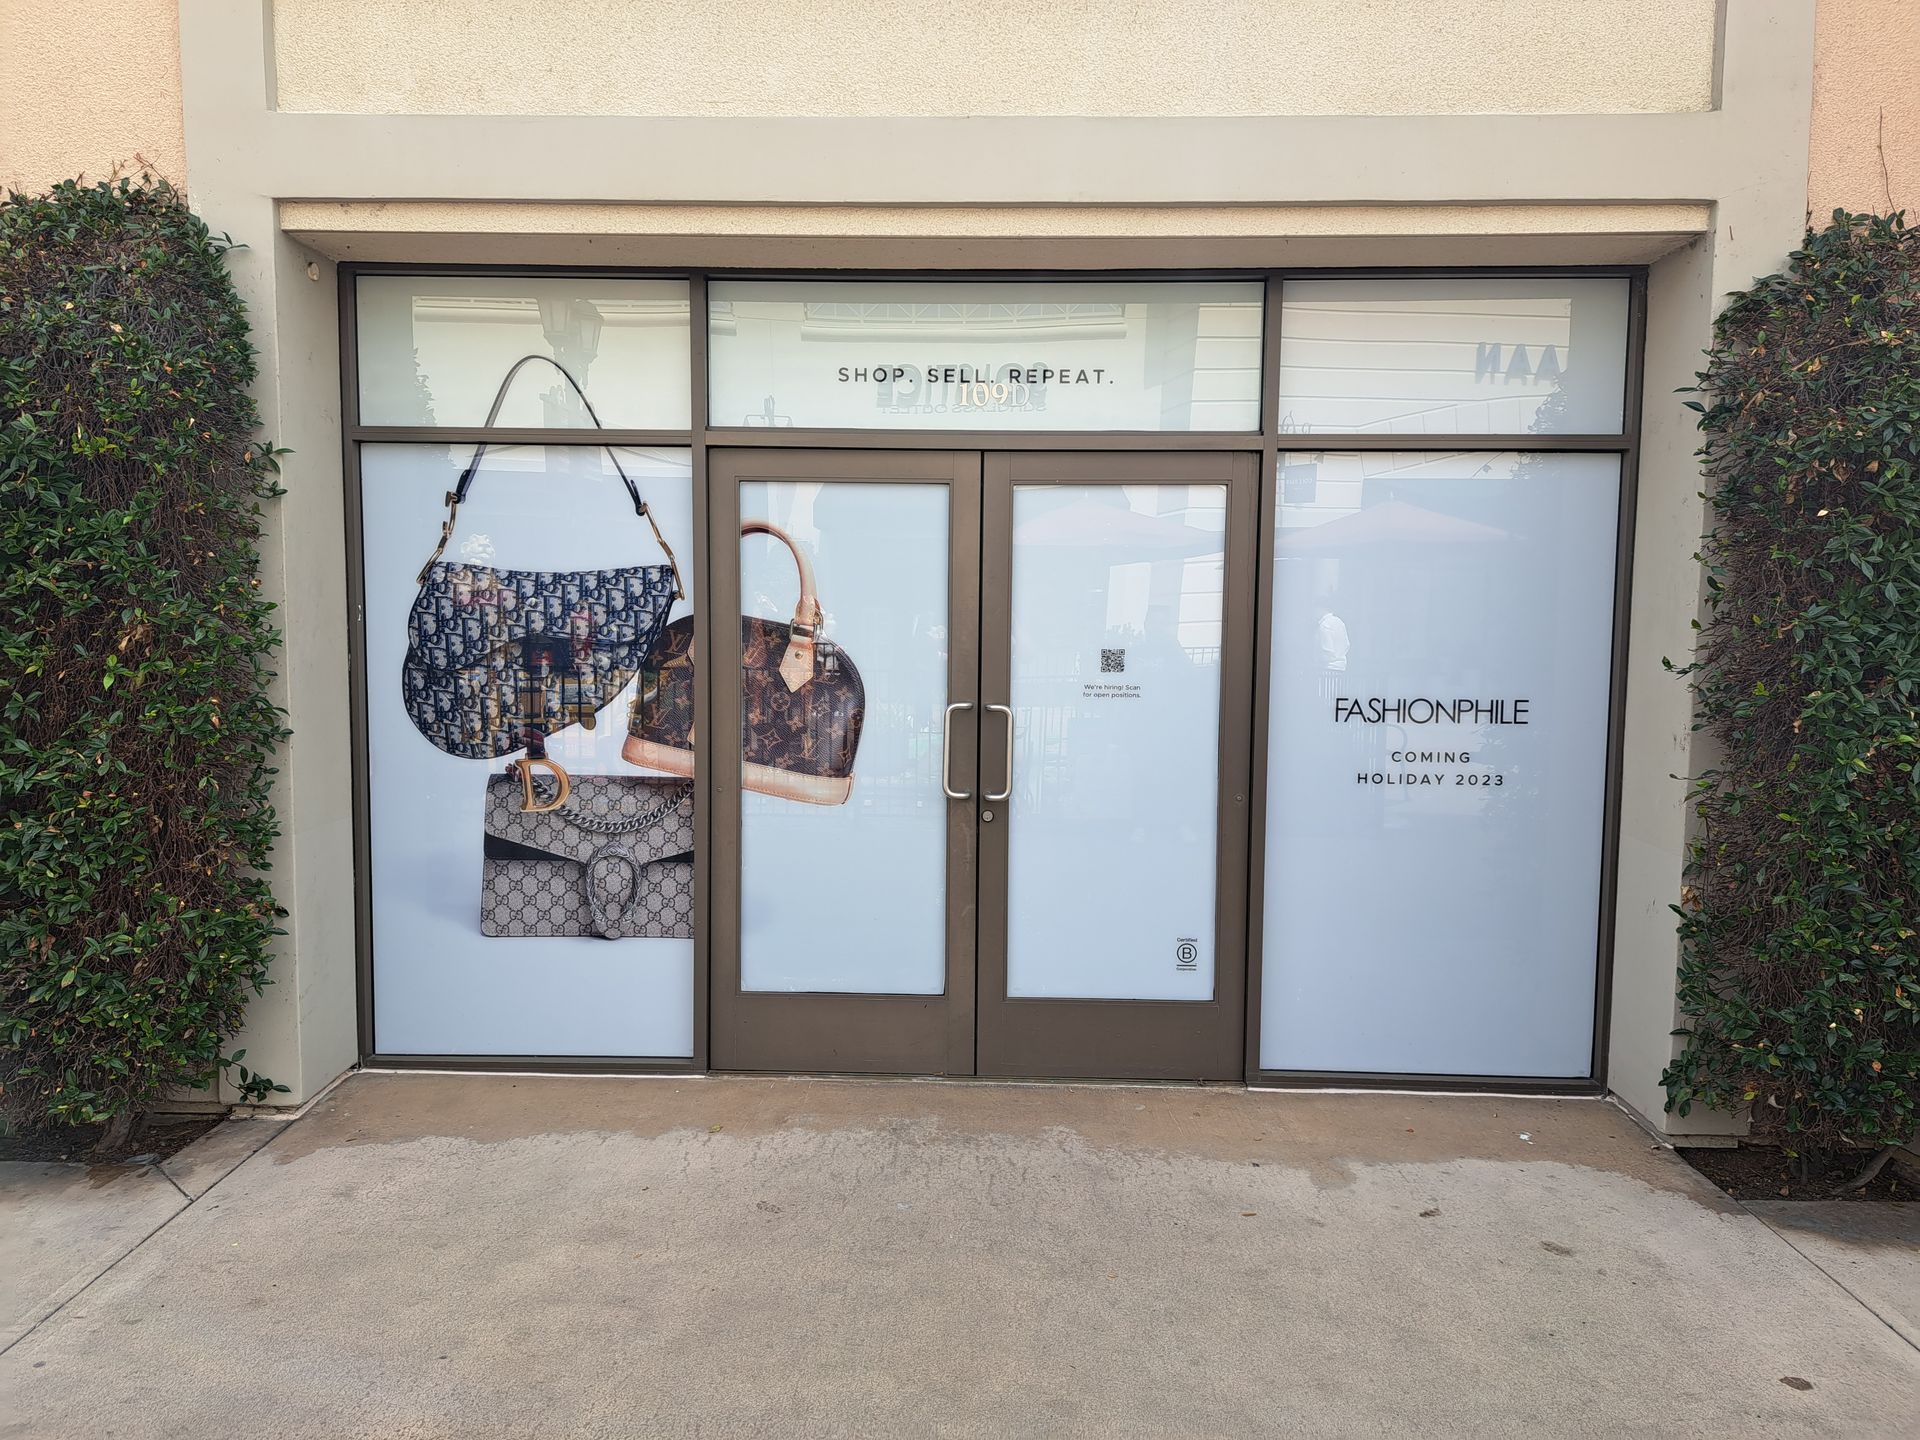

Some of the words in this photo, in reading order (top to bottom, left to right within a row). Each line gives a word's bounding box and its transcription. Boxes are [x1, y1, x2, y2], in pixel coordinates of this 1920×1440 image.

[838, 367, 913, 383] SHOP.
[927, 368, 994, 384] SELL.
[1009, 368, 1114, 385] REPEAT.
[959, 382, 1030, 408] 109D
[1335, 698, 1529, 724] FASHIONPHILE
[1391, 751, 1471, 763] COMING
[1357, 773, 1445, 785] HOLIDAY
[1456, 774, 1504, 786] 2023
